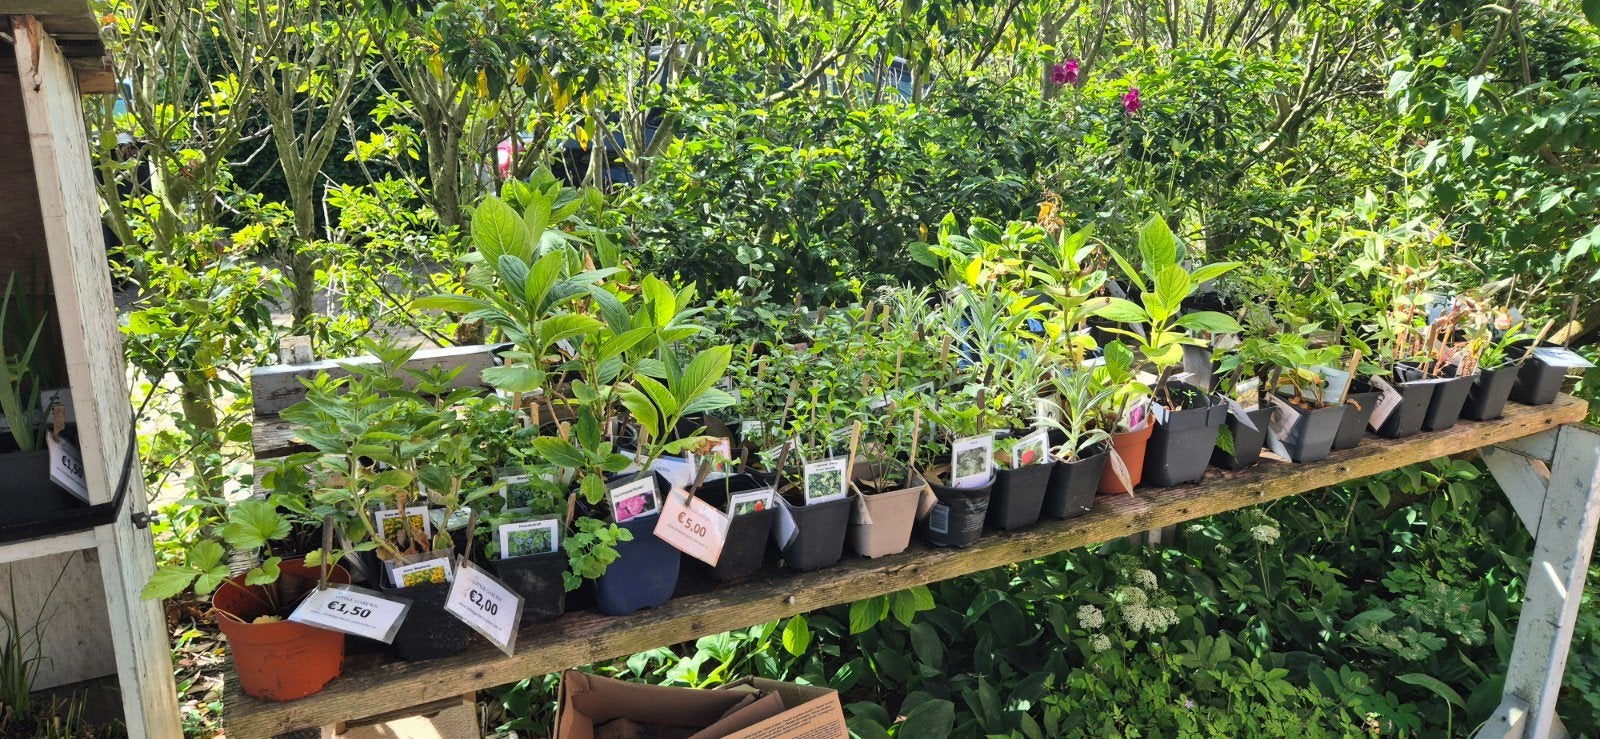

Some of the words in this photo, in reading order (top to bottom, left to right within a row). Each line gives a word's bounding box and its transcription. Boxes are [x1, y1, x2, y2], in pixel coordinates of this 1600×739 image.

[62, 455, 83, 478] €1,50
[327, 601, 372, 618] €1,50
[469, 589, 498, 616] €2,00
